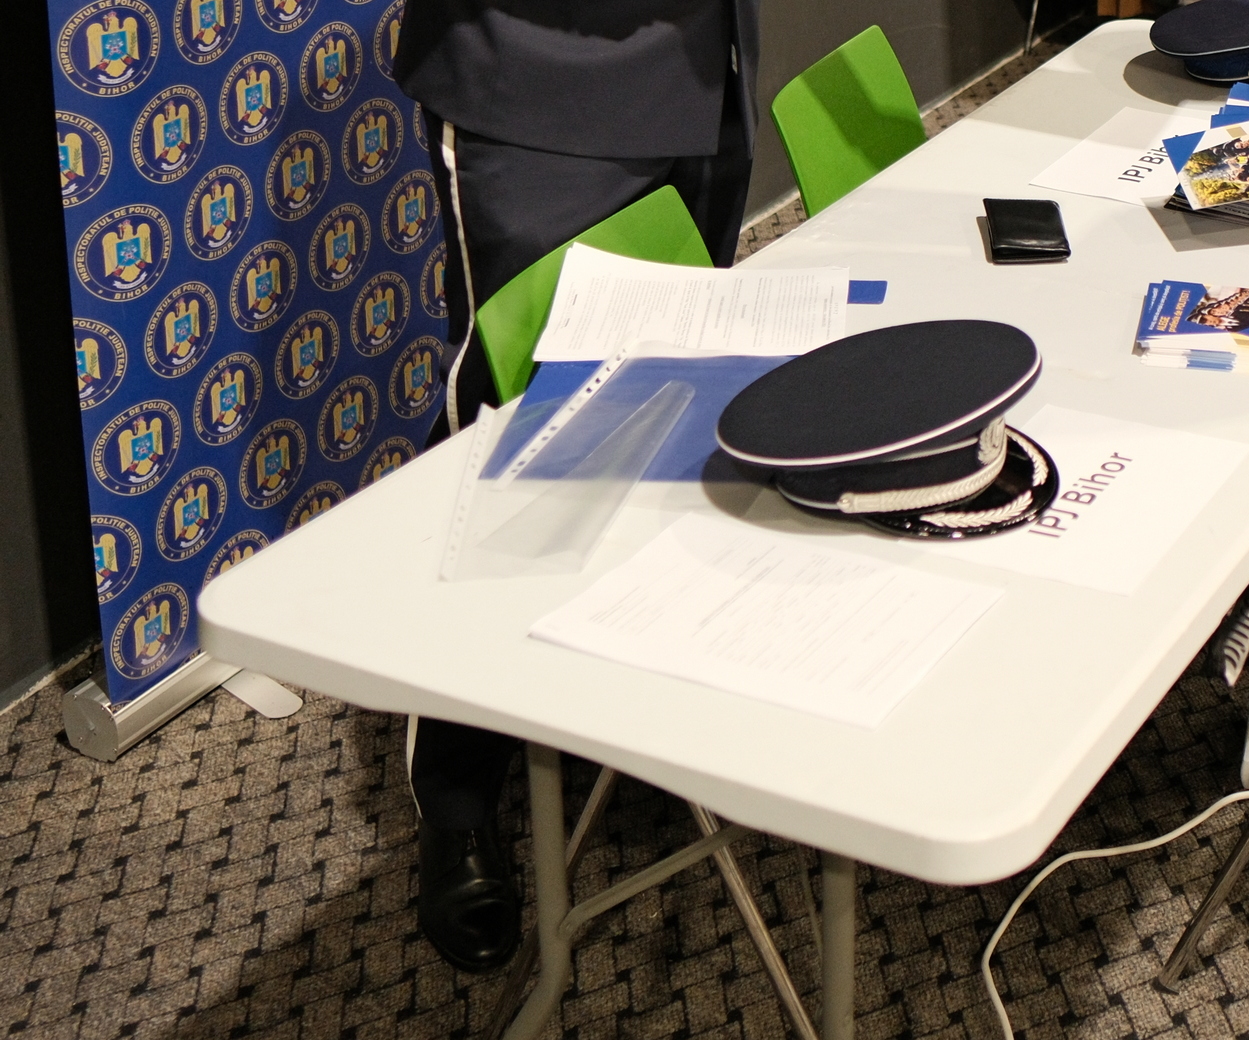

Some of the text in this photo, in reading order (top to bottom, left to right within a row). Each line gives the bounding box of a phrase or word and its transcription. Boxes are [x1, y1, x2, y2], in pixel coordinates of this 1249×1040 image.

[98, 0, 112, 8] DE
[99, 81, 135, 94] BIHOR
[162, 90, 170, 98] DE
[162, 165, 188, 180] BIHOR
[1118, 165, 1153, 183] IPJ
[113, 208, 126, 217] DE
[114, 284, 148, 299] BIHOR
[128, 406, 140, 415] DE
[129, 476, 160, 493] BIHOR
[1028, 452, 1133, 538] IPJ Bihor
